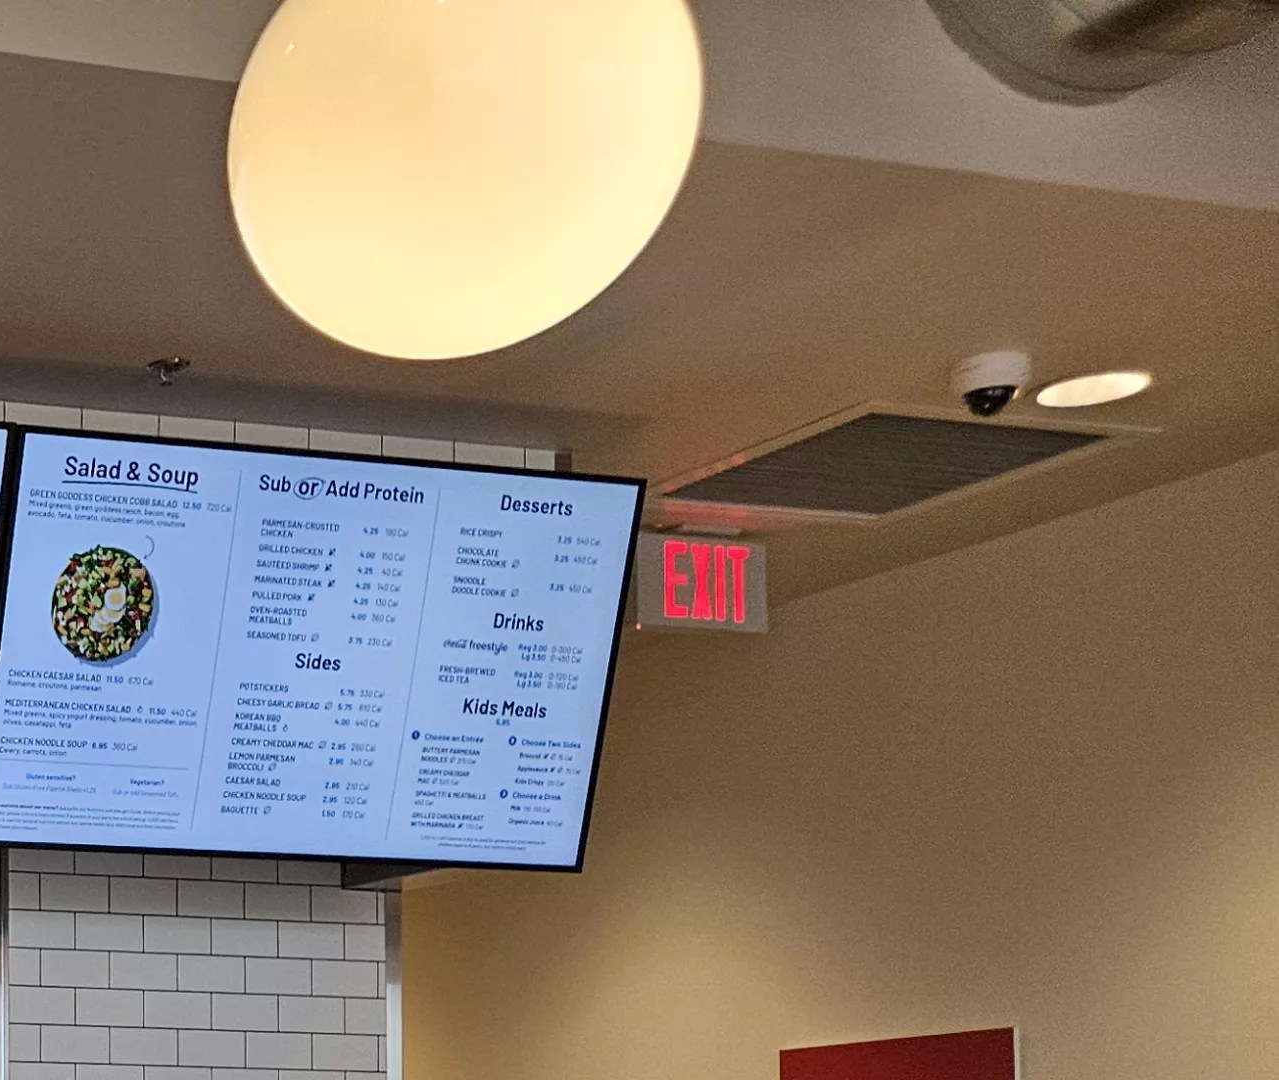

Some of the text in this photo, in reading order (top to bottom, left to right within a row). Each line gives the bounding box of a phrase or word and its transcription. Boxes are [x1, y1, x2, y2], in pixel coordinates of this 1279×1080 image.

[65, 456, 199, 492] Salad & Soup
[259, 474, 425, 504] Sub or Add Protein
[500, 494, 573, 516] Desserts
[664, 540, 751, 624] EXIT
[493, 612, 544, 632] Drinks
[469, 639, 509, 655] freestyle
[295, 653, 341, 671] Sides
[462, 698, 548, 719] Kids Meals
[0, 736, 88, 748] CHICKEN NOODLE SOUP
